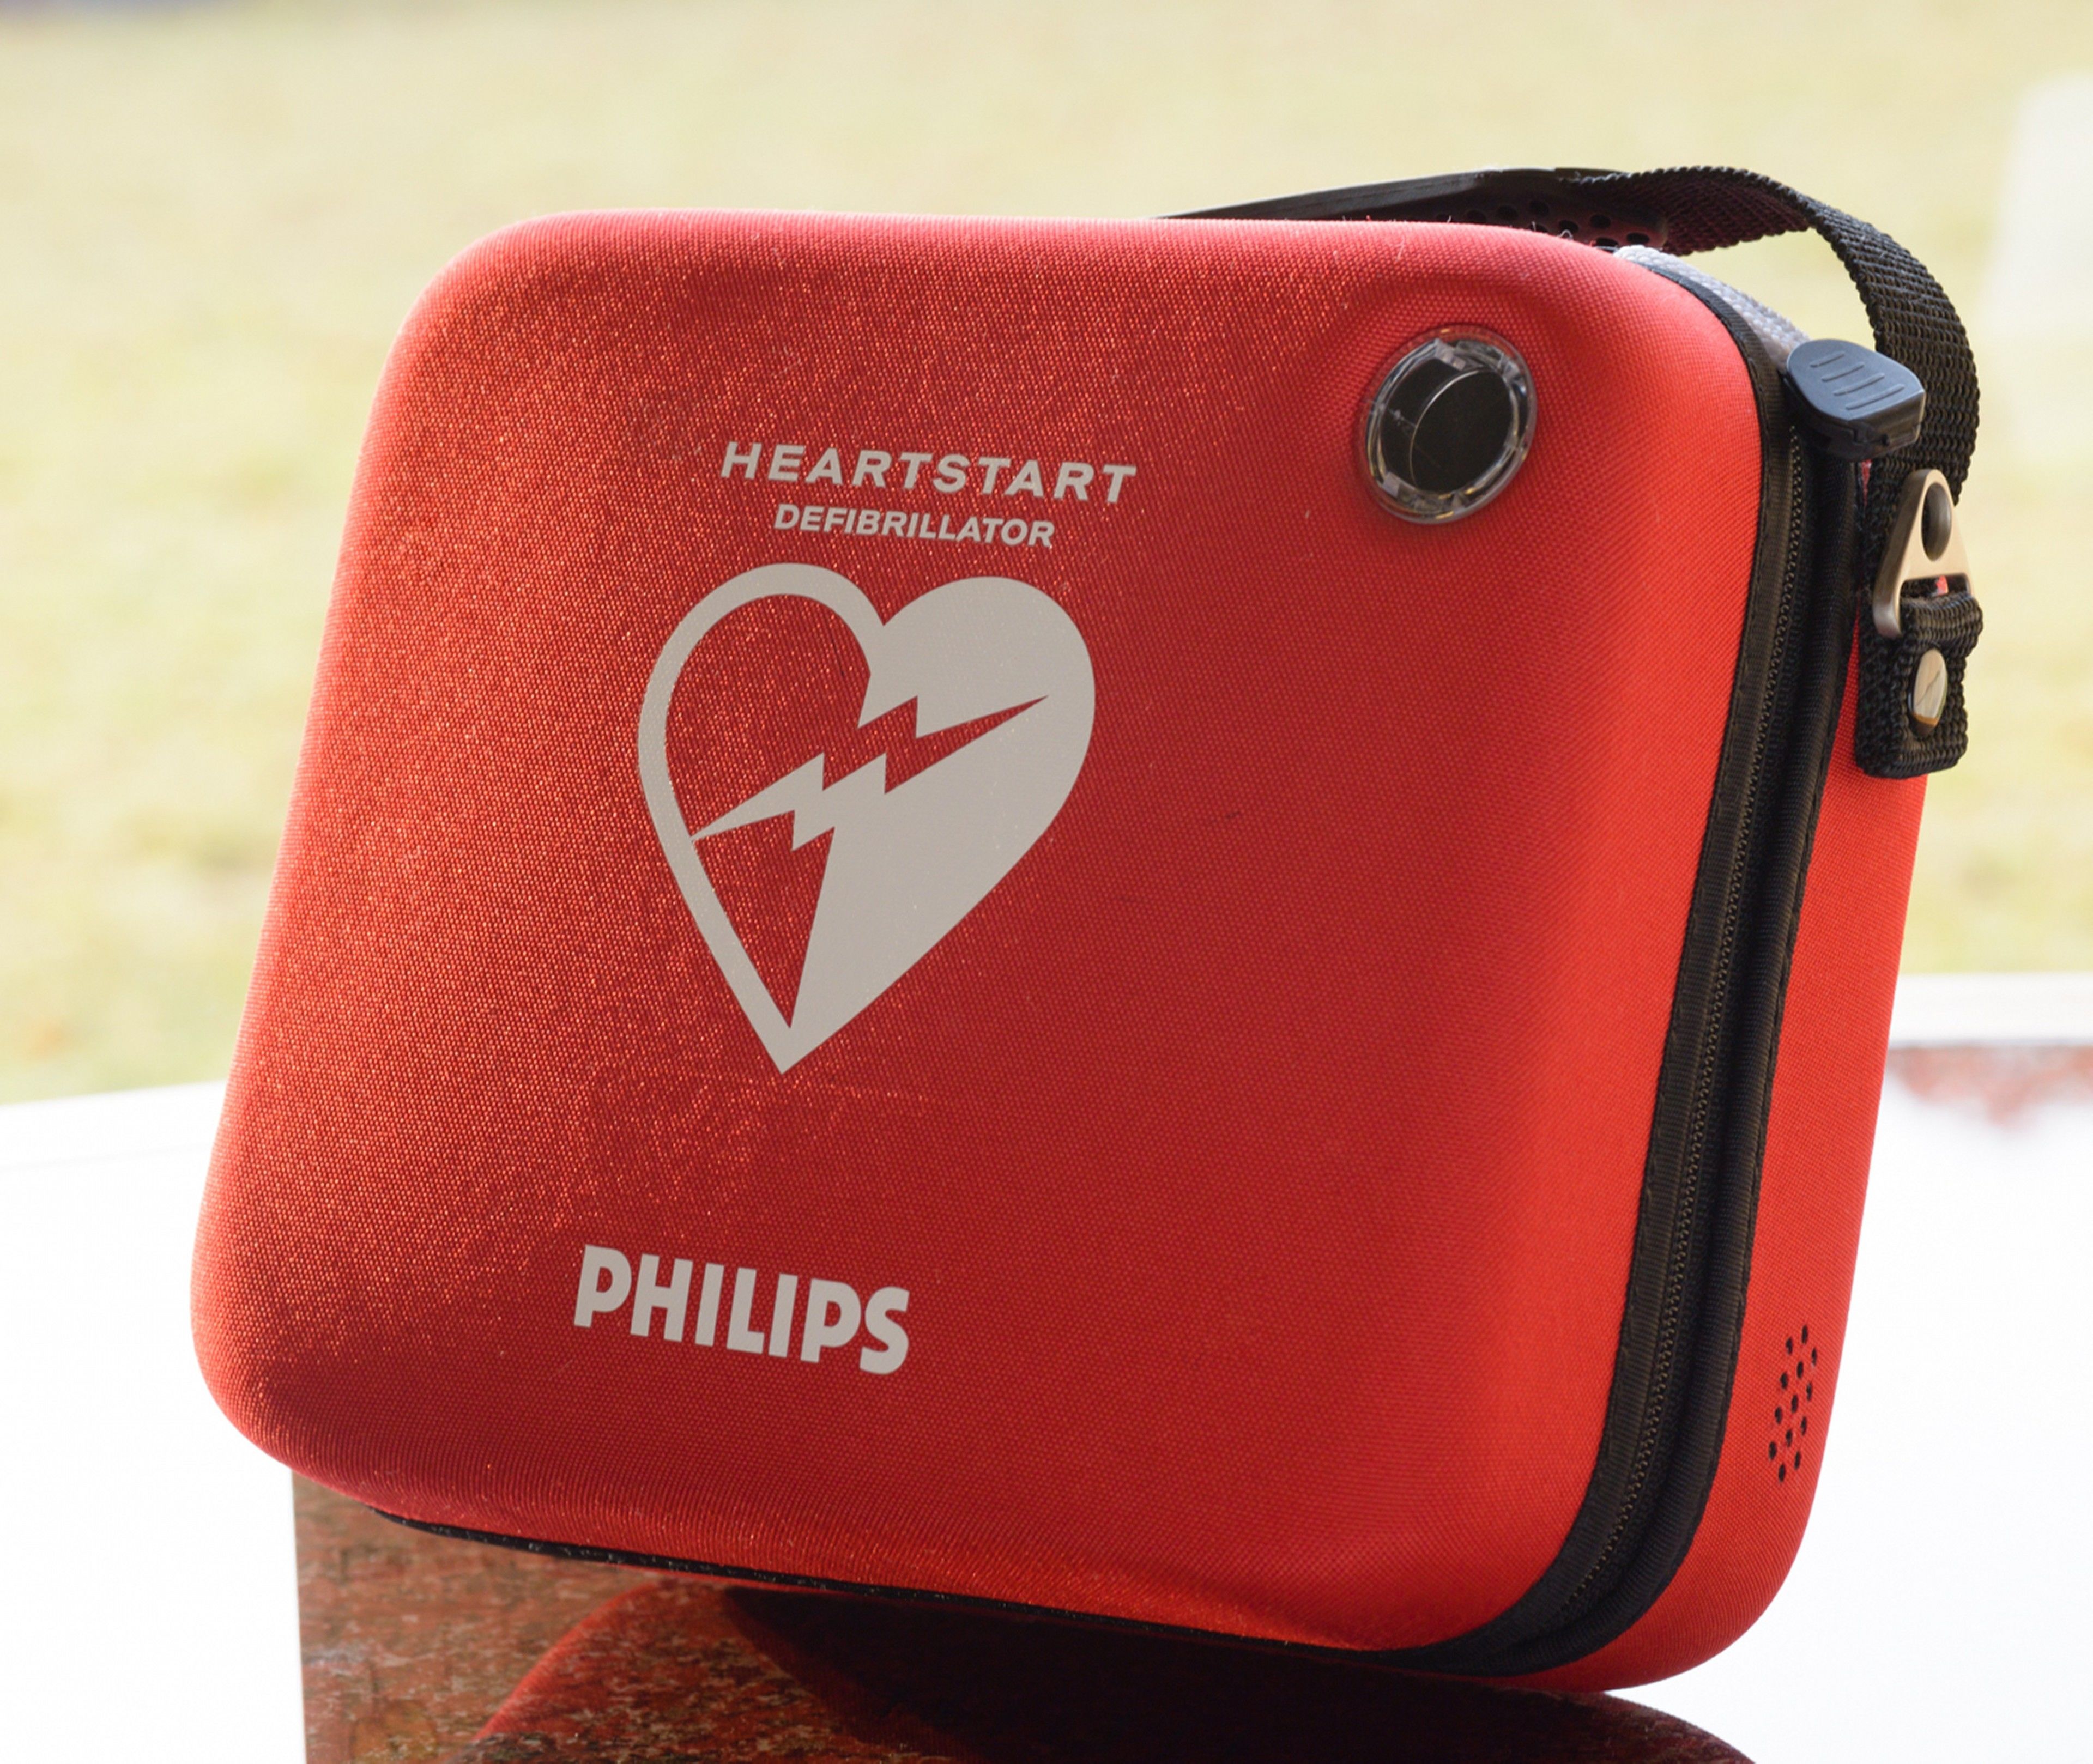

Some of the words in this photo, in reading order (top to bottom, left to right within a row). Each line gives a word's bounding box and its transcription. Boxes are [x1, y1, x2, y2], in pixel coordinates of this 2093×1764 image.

[720, 441, 1138, 505] HEARTSTART
[773, 503, 1056, 549] DEFIBRILLATOR
[573, 1244, 911, 1375] PHILIPS
